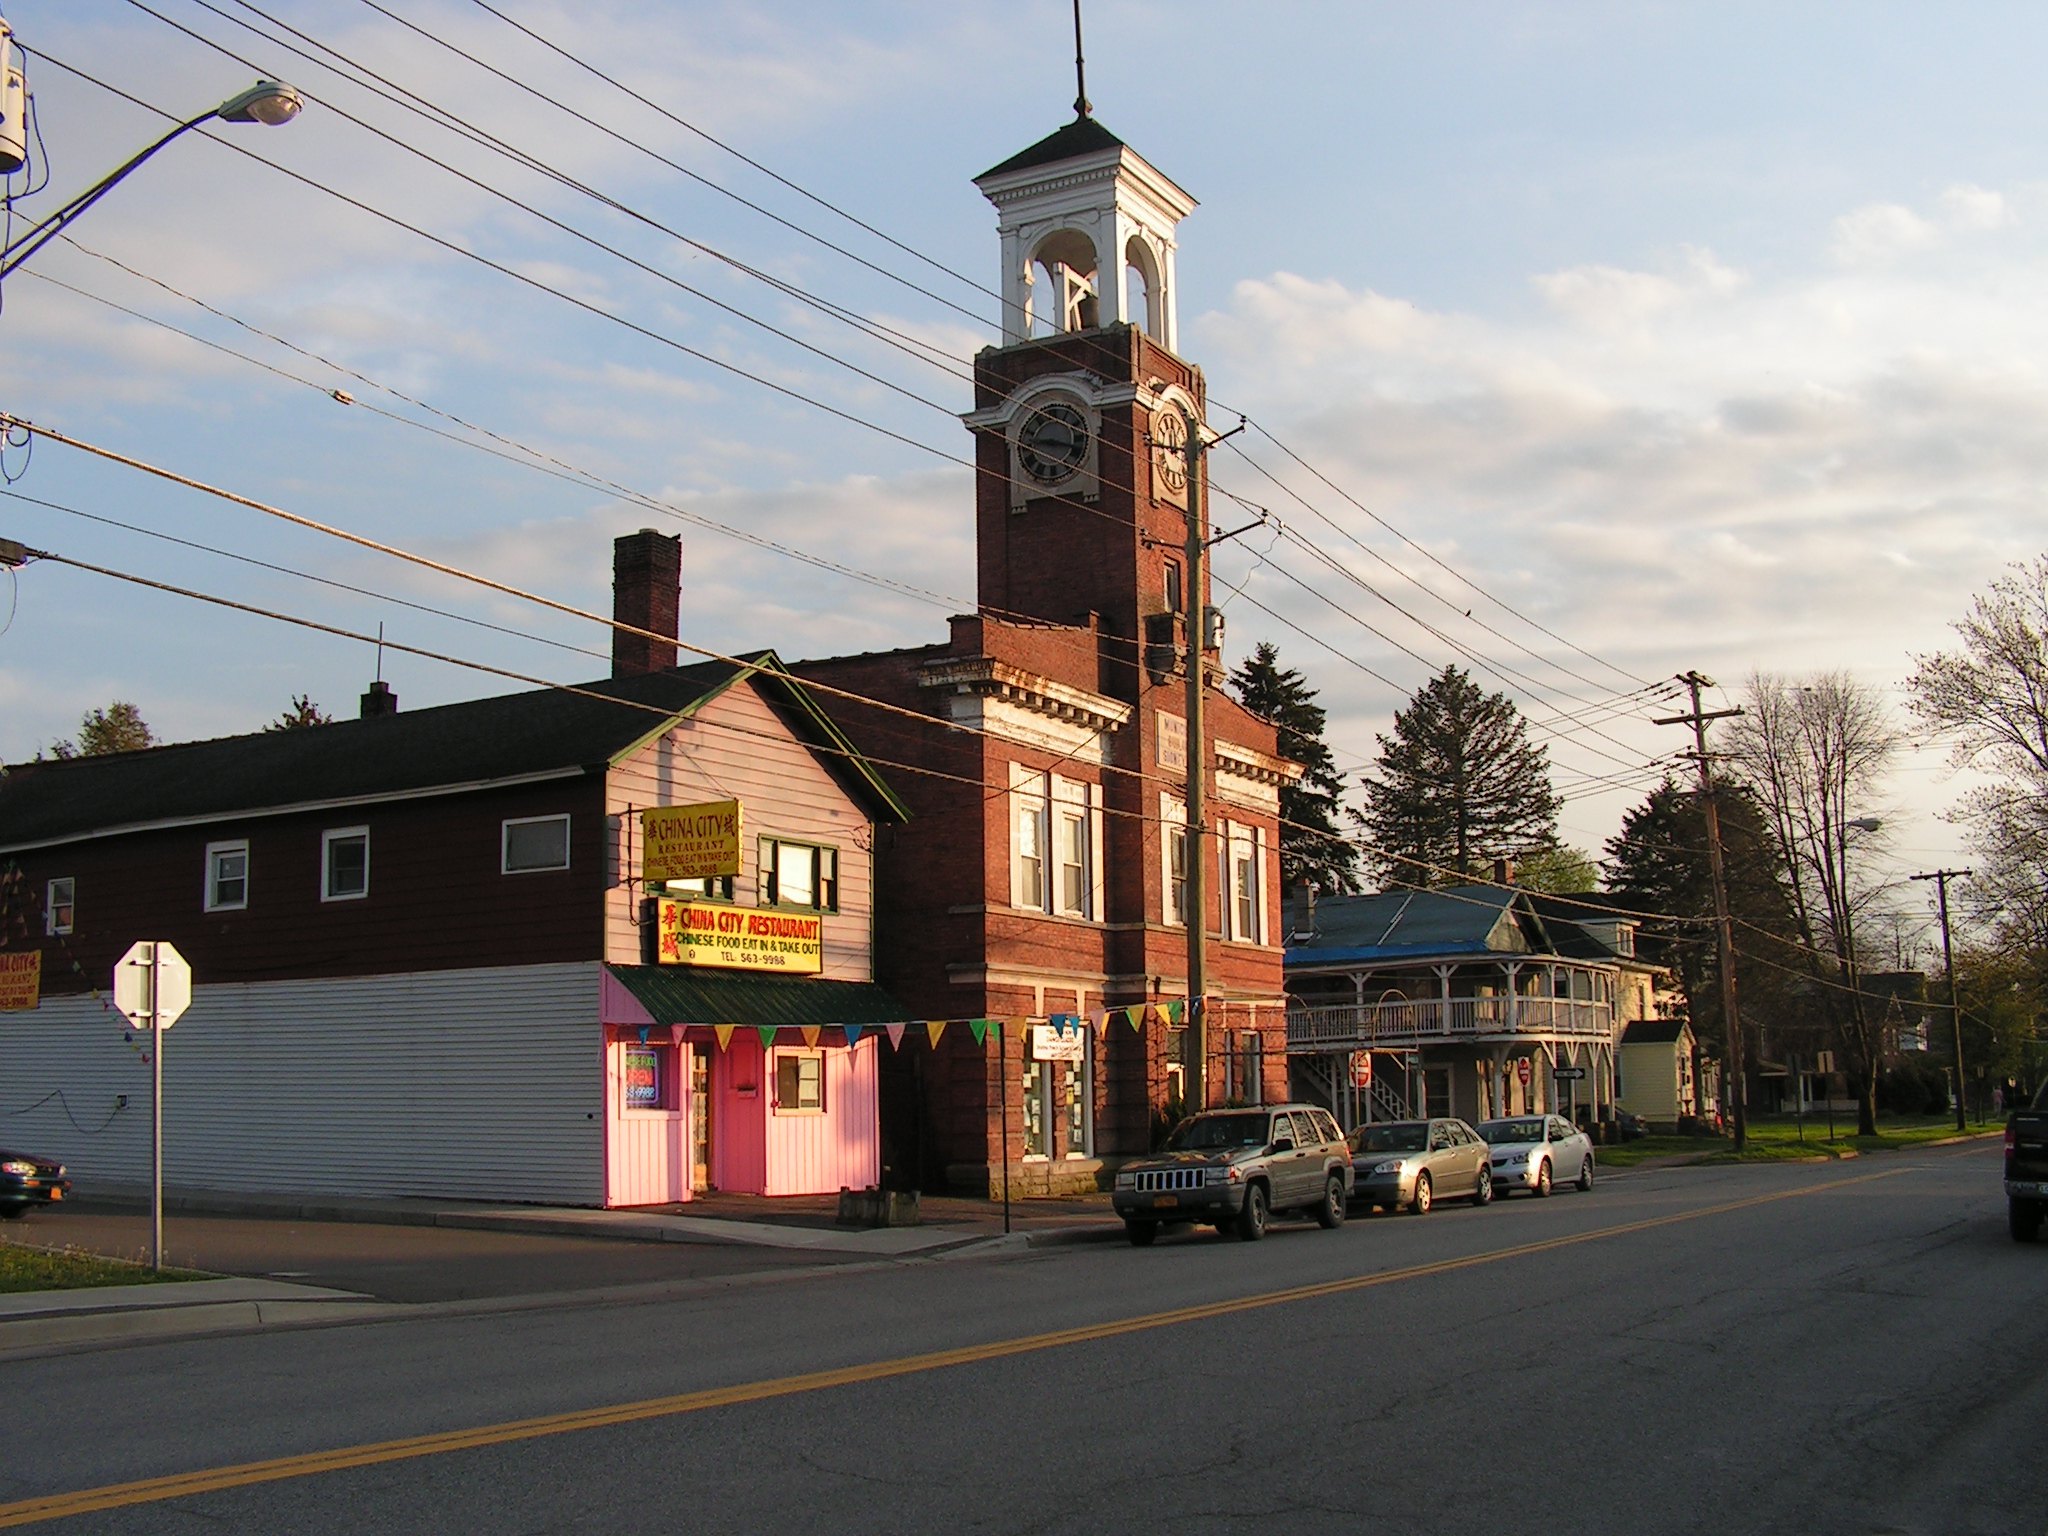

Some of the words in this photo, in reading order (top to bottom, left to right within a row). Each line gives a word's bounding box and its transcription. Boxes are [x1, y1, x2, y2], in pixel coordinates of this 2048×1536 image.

[659, 817, 694, 840] CHINA
[696, 815, 722, 838] CITY
[658, 840, 724, 854] RESTAURANT
[681, 907, 715, 931] CHINA
[718, 911, 744, 934] CITY
[748, 914, 819, 940] RESTAURANT
[675, 931, 715, 946] CHINESE
[716, 935, 741, 949] FOOD
[742, 938, 758, 950] EAT
[760, 939, 769, 951] IN
[770, 940, 777, 952] &
[778, 941, 801, 954] TAKE
[801, 942, 820, 955] OUT
[741, 953, 786, 966] 563-9988
